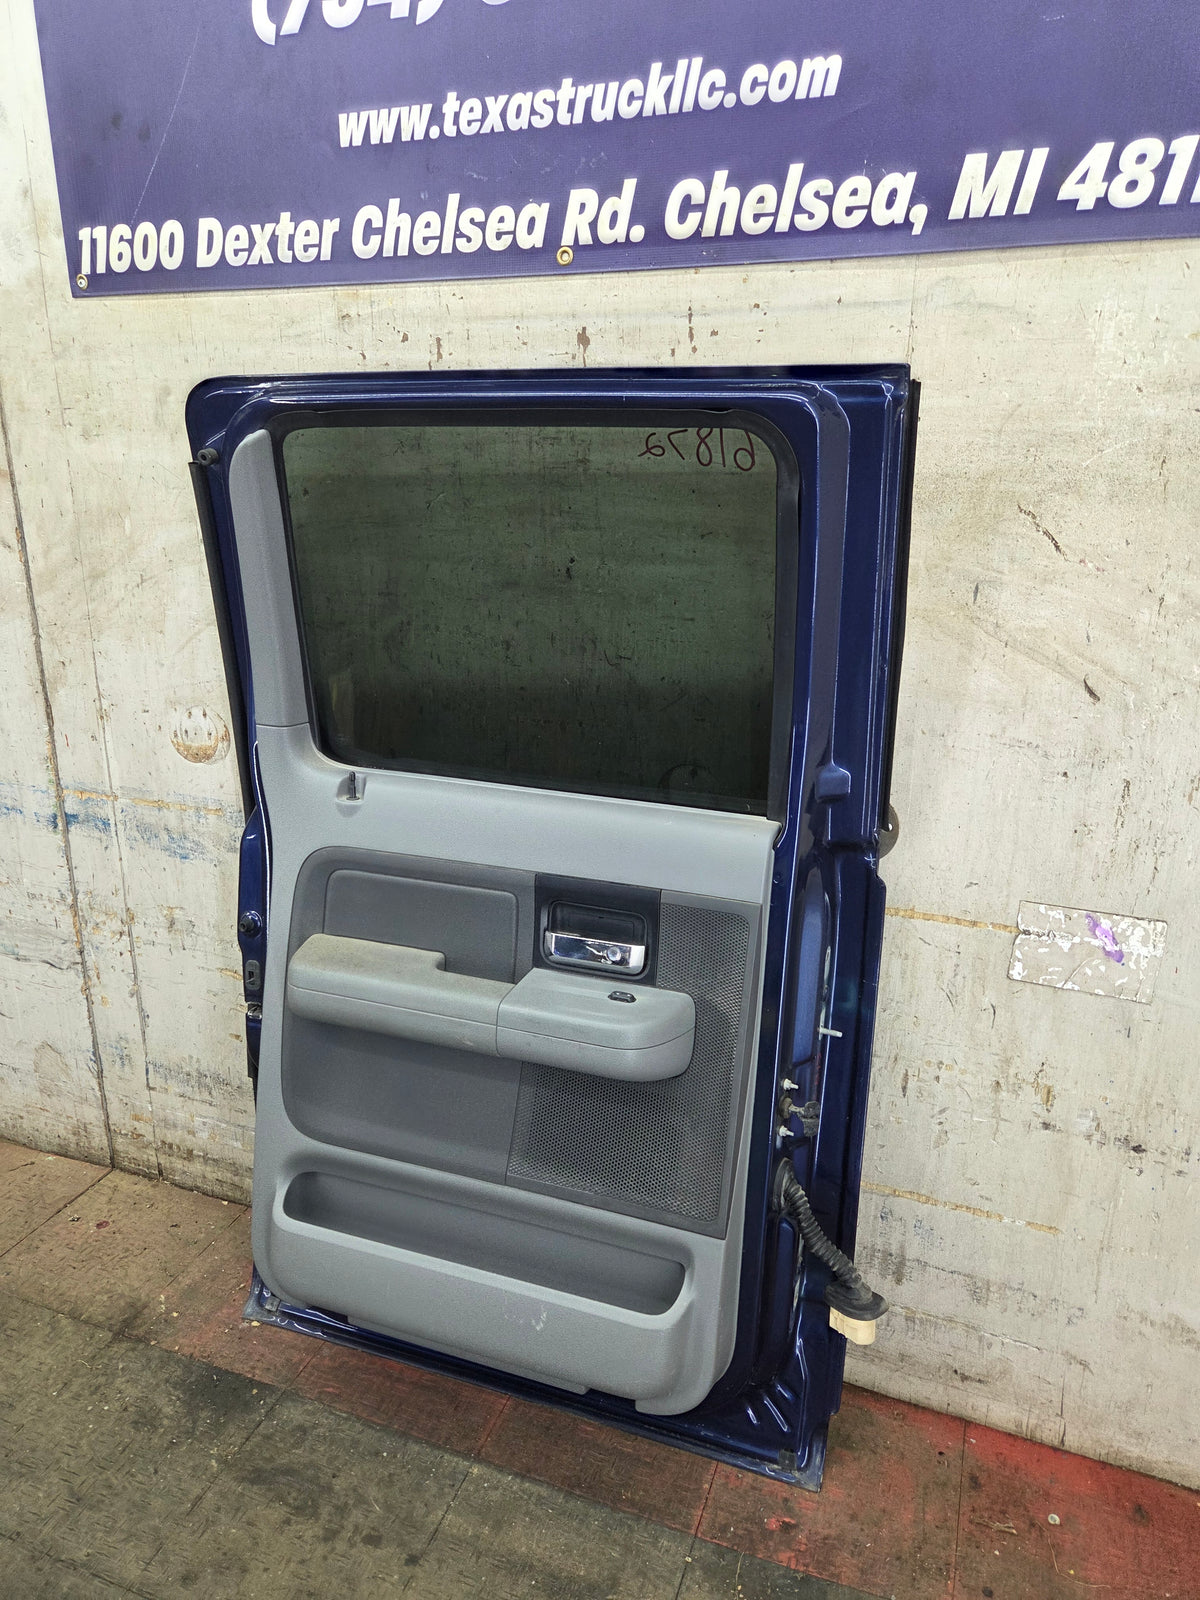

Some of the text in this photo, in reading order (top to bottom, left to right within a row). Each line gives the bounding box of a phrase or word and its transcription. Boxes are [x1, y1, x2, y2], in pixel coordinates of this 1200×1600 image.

[338, 54, 843, 148] www.texastruckllc.com
[77, 134, 1200, 275] 11600 Dexter Chelsea Rd. Chelsea, MI 481
